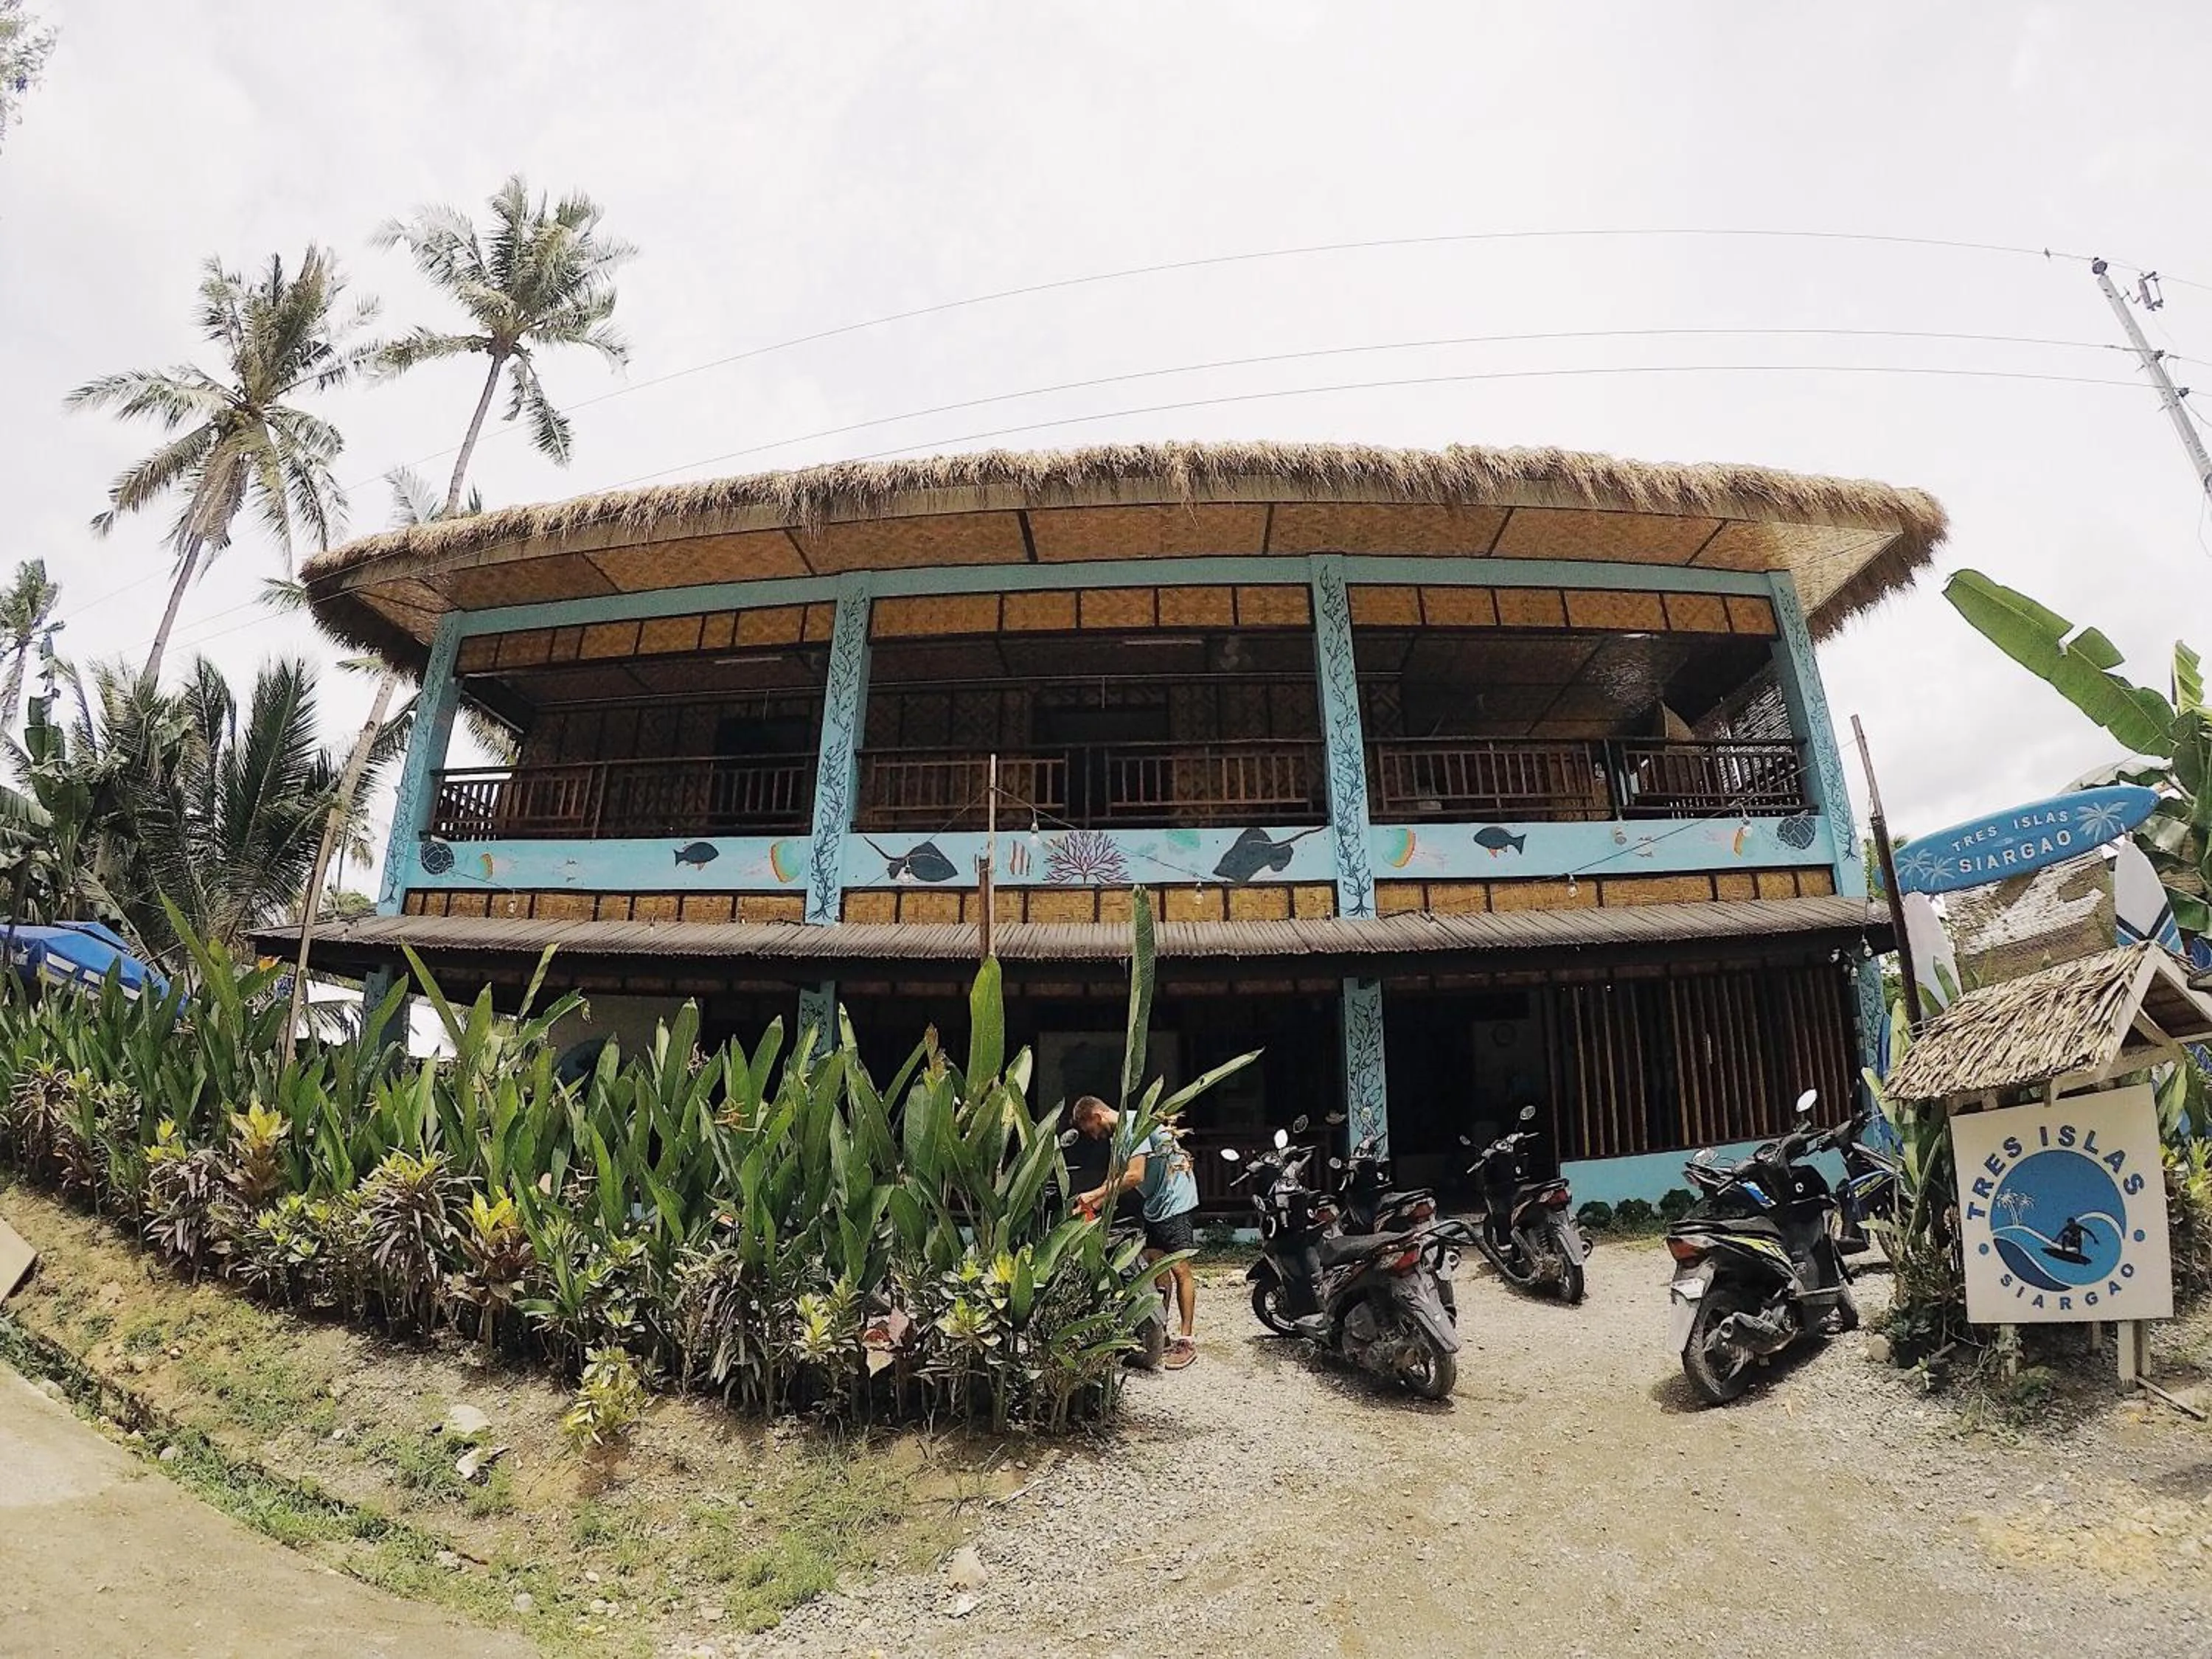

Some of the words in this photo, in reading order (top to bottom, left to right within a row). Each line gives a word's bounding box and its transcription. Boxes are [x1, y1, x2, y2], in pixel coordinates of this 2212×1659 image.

[1952, 825, 1997, 852] TRES
[2014, 810, 2069, 829] ISLAS
[1959, 830, 2071, 873] SIARGAO
[1967, 1136, 2023, 1220] TRES
[2039, 1124, 2145, 1195] ISLAS
[2000, 1263, 2135, 1310] SIARGAO
